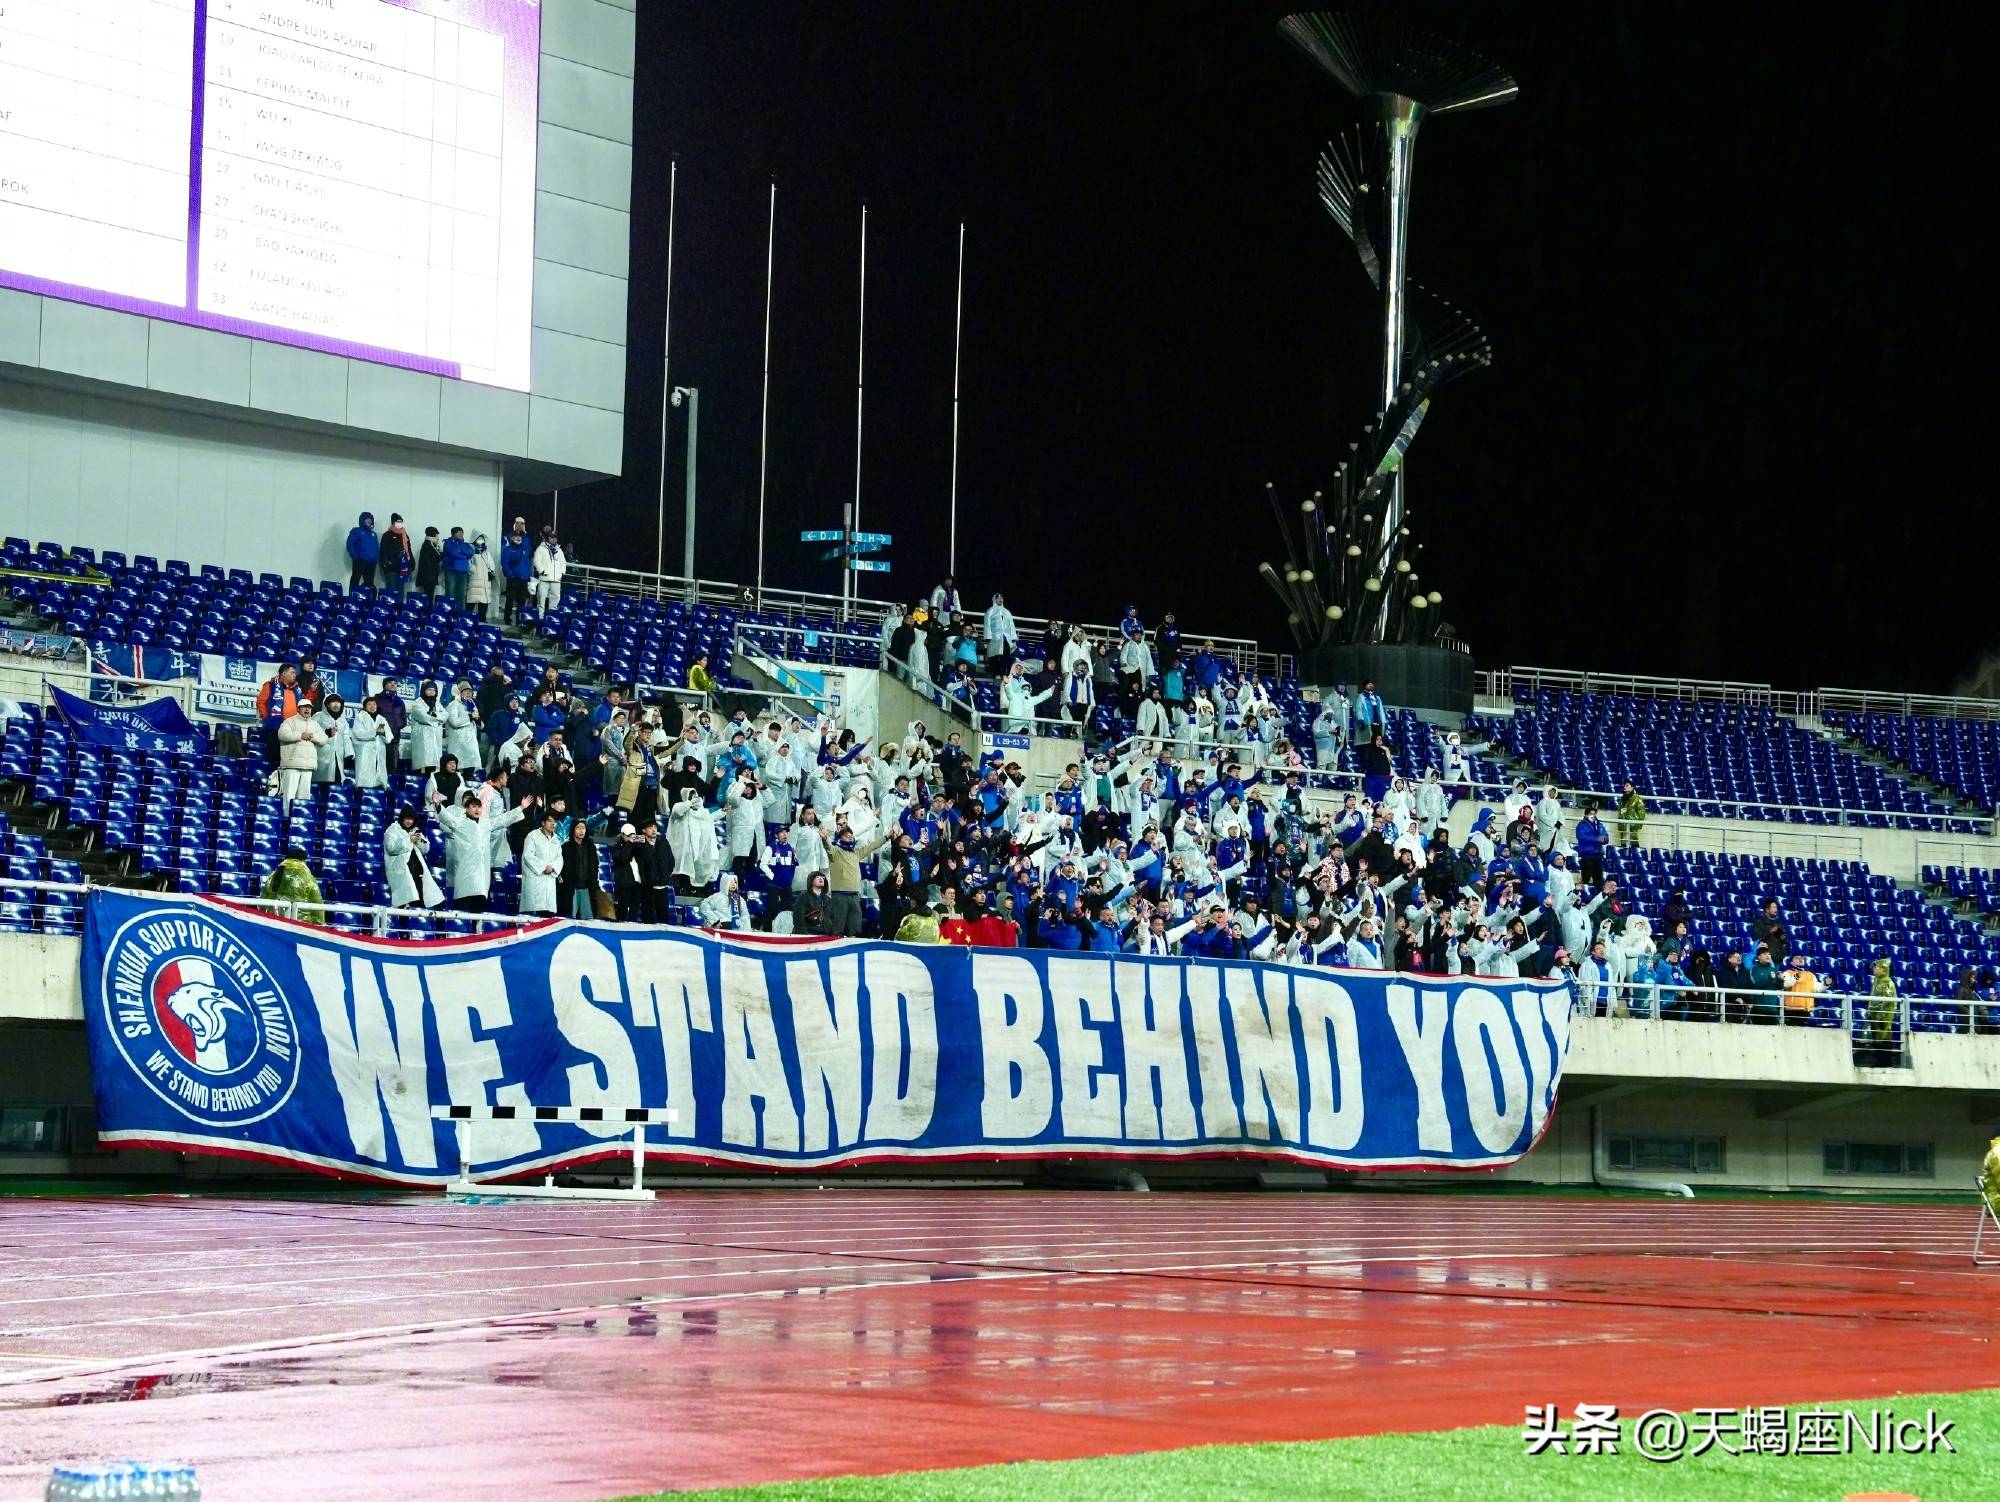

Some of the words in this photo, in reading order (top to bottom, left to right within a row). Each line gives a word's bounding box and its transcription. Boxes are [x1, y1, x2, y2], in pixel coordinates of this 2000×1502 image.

[259, 12, 300, 32] ANDRE
[304, 24, 329, 41] LUIS
[114, 940, 154, 1039] SHENHUA
[138, 919, 264, 988] SUPPORTERS
[252, 990, 291, 1062] UNION
[145, 1050, 174, 1081] WE
[168, 1069, 209, 1110] STAND
[211, 1081, 261, 1112] BEHIND
[253, 1063, 283, 1097] YOU
[297, 943, 543, 1169] WE
[549, 932, 940, 1153] STAND
[972, 953, 1365, 1151] BEHIND
[1387, 984, 1573, 1156] YOU
